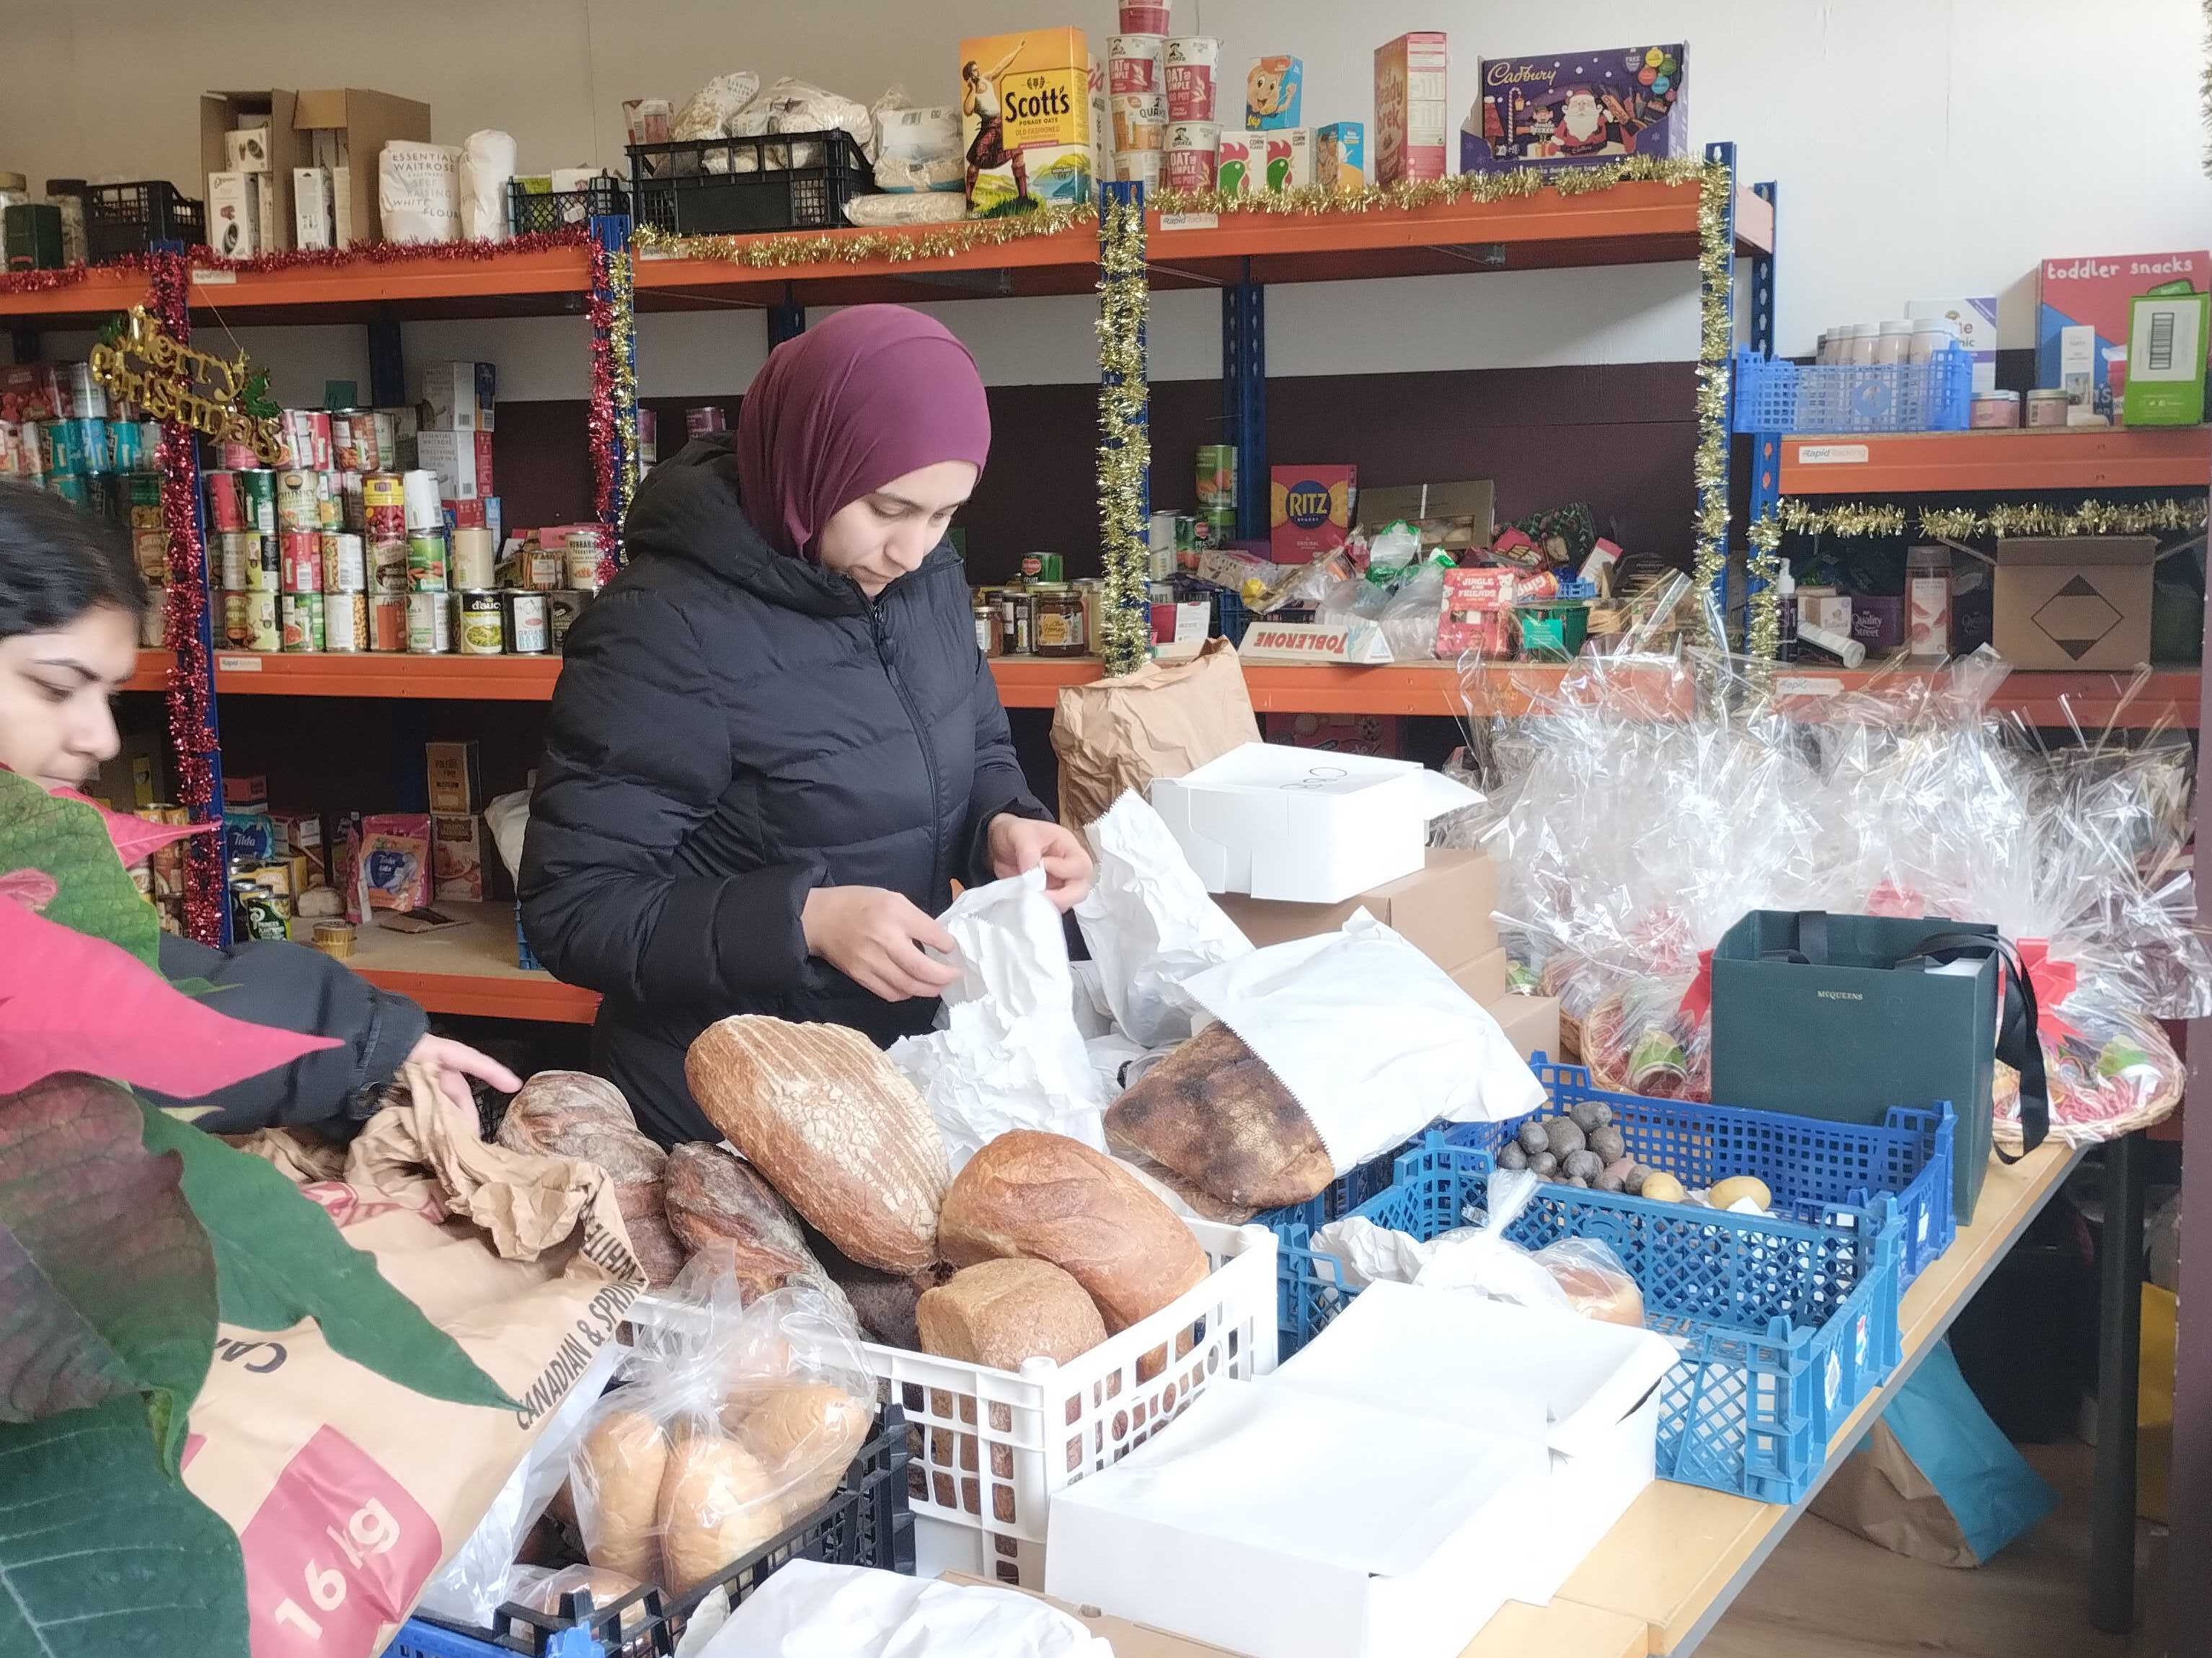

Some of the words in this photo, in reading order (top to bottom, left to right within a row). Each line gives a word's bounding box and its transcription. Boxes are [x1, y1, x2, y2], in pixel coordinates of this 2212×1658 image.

[1167, 68, 1184, 83] OAT
[1487, 61, 1557, 87] Cadbury
[1004, 85, 1070, 123] Scott's
[392, 152, 456, 162] ESSENTIAL
[1169, 152, 1190, 166] OAT
[392, 162, 456, 172] WAITROSE
[2046, 260, 2120, 281] toddler
[2129, 256, 2194, 276] snacks
[1289, 493, 1327, 516] RITZ
[1461, 577, 1495, 586] JINGLE
[1458, 589, 1496, 598] FRIENDS
[1851, 612, 1883, 627] Quality
[1852, 624, 1881, 638] Street
[1253, 631, 1348, 654] TOBLERONE
[233, 832, 256, 847] Tilda
[517, 1333, 593, 1424] CANADIAN
[577, 1319, 606, 1347] &
